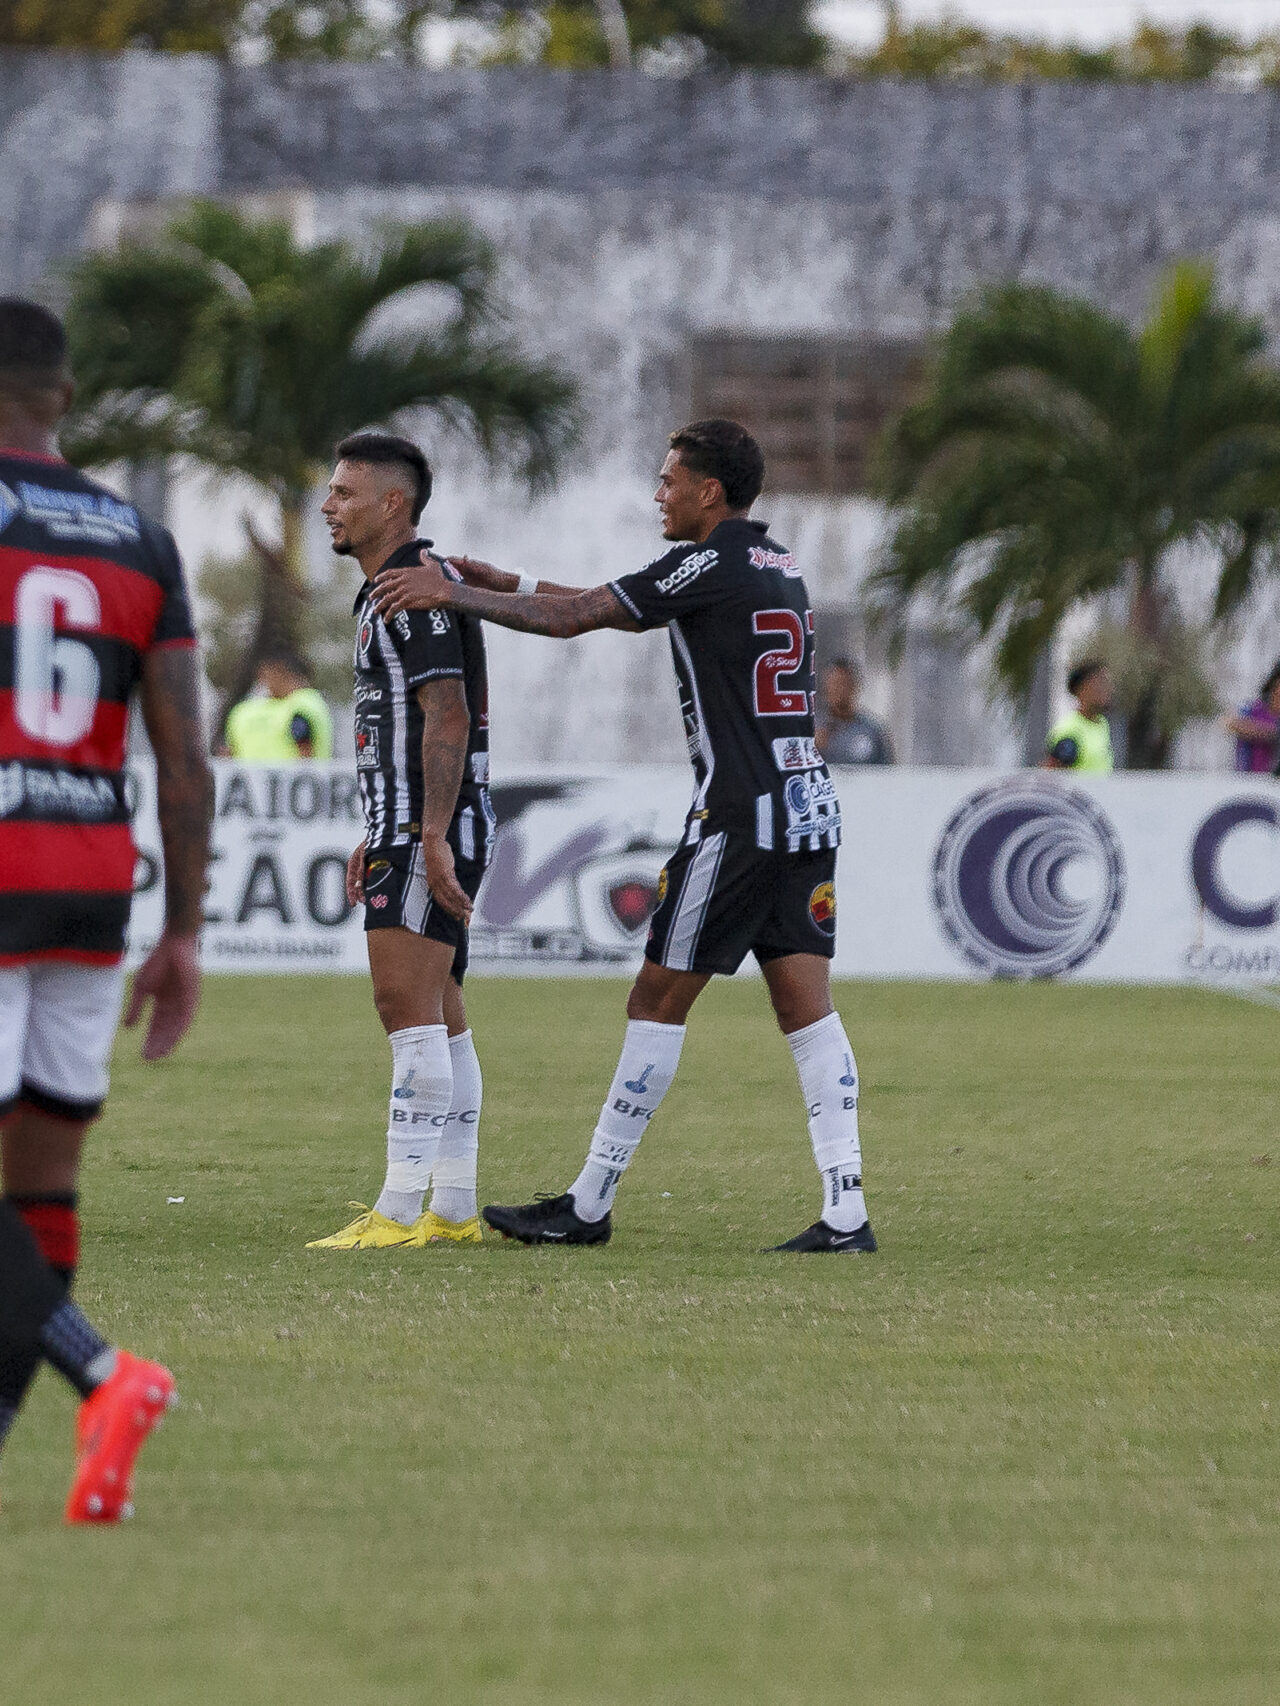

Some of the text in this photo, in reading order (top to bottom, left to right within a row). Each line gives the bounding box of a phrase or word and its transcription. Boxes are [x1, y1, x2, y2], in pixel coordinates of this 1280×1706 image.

[13, 564, 102, 748] 6
[752, 608, 815, 717] 2
[220, 772, 361, 820] AIOR
[444, 1110, 478, 1125] FC
